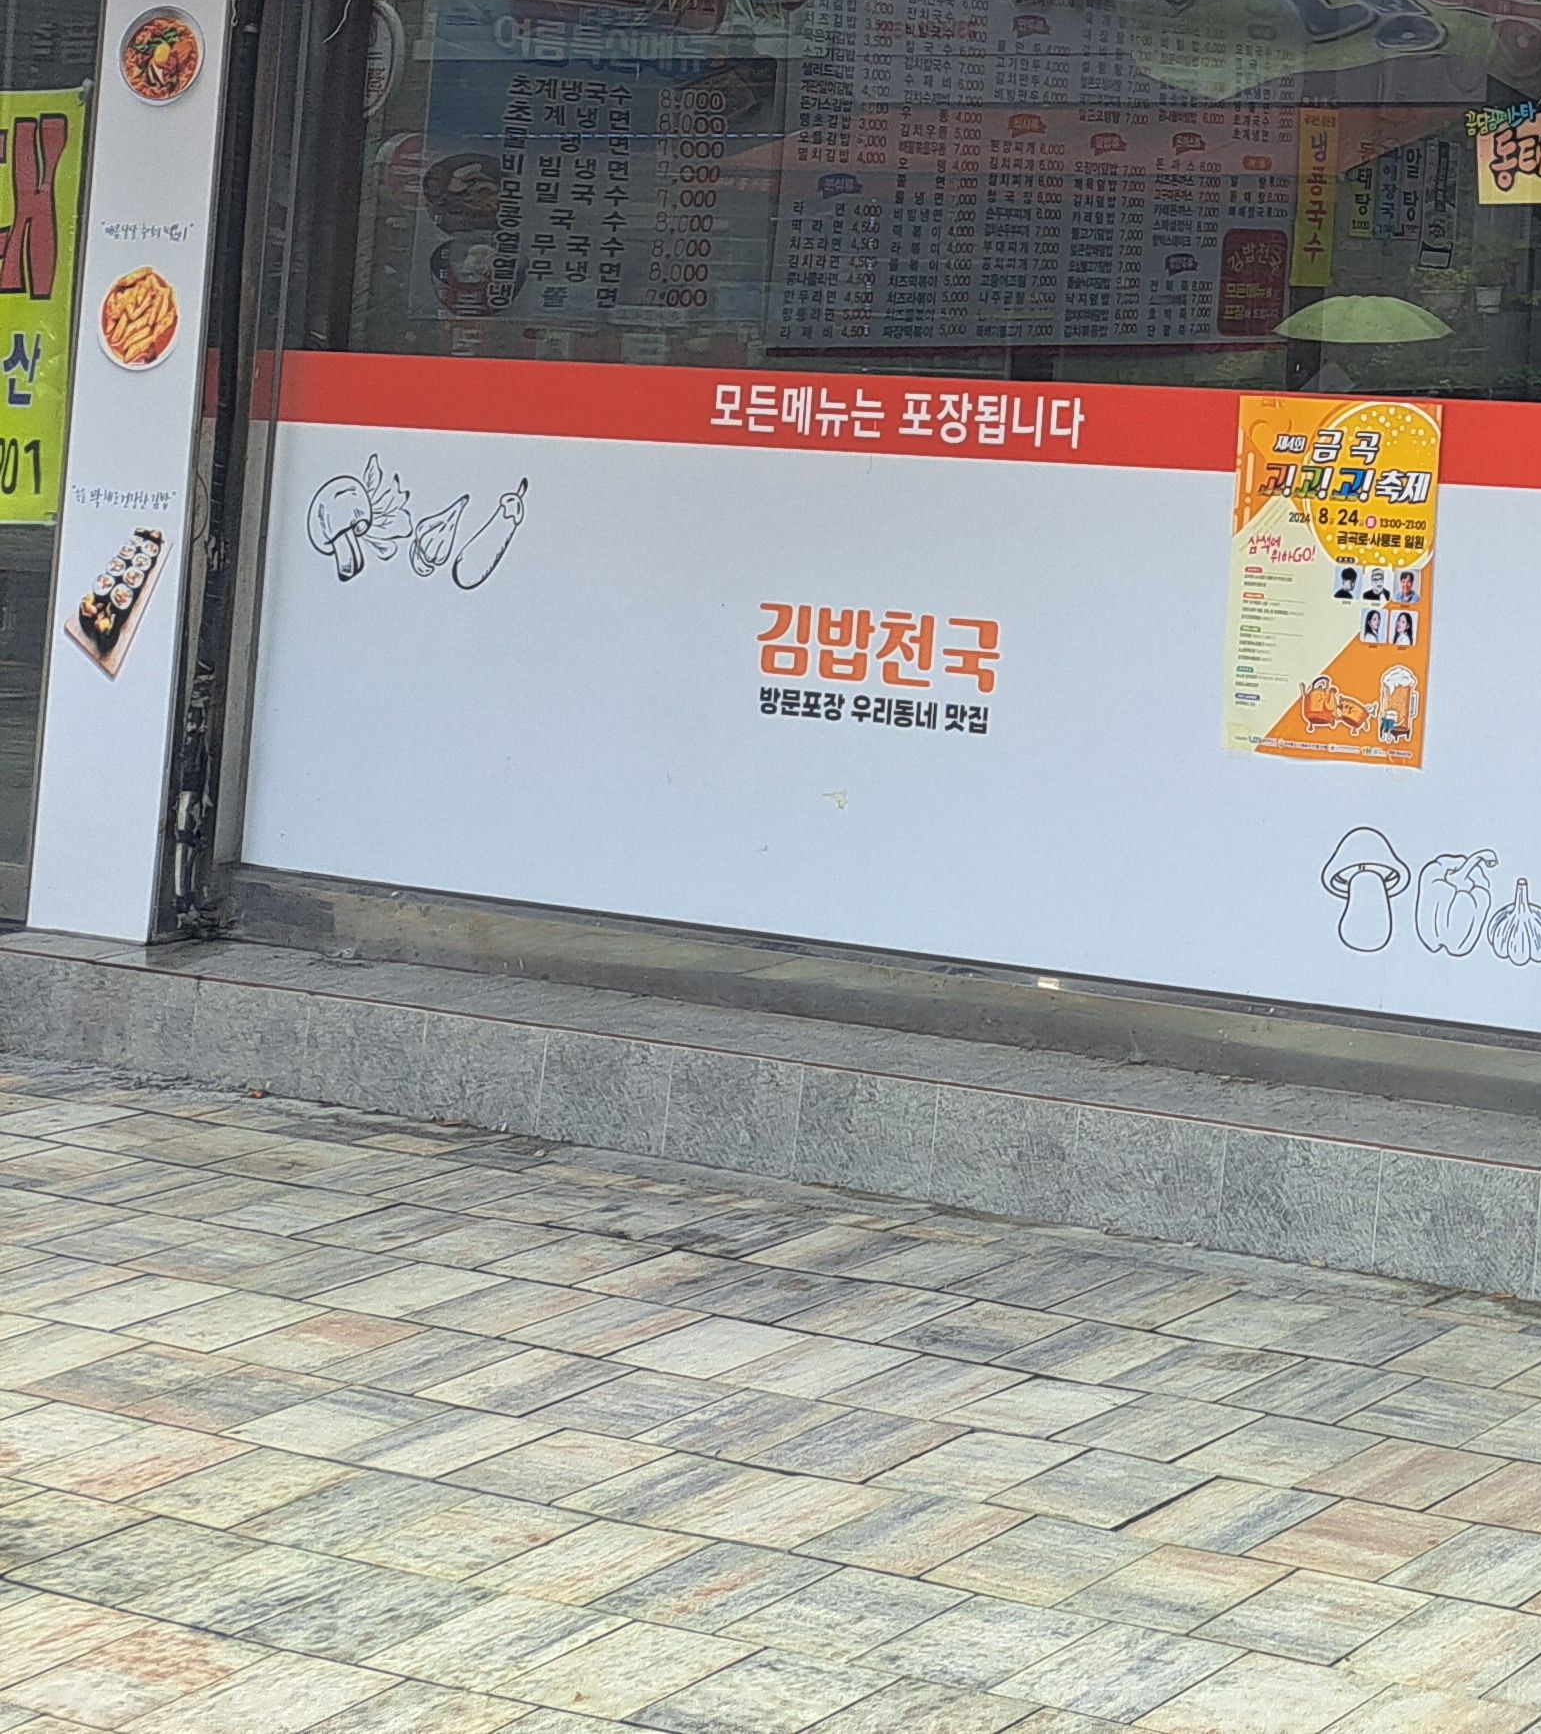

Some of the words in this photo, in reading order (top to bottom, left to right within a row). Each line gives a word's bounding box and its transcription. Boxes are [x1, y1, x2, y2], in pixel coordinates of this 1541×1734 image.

[1402, 147, 1424, 221] 알탕
[709, 382, 887, 440] 모든메뉴는
[898, 391, 1086, 450] 포장됩니다
[1311, 428, 1381, 465] 금곡
[1375, 469, 1433, 505] 축제
[1288, 511, 1311, 524] 2024
[755, 601, 1002, 694] 김밥천국
[758, 686, 846, 722] 방문포장
[850, 695, 939, 731] 우리동네
[944, 702, 990, 735] 맛집
